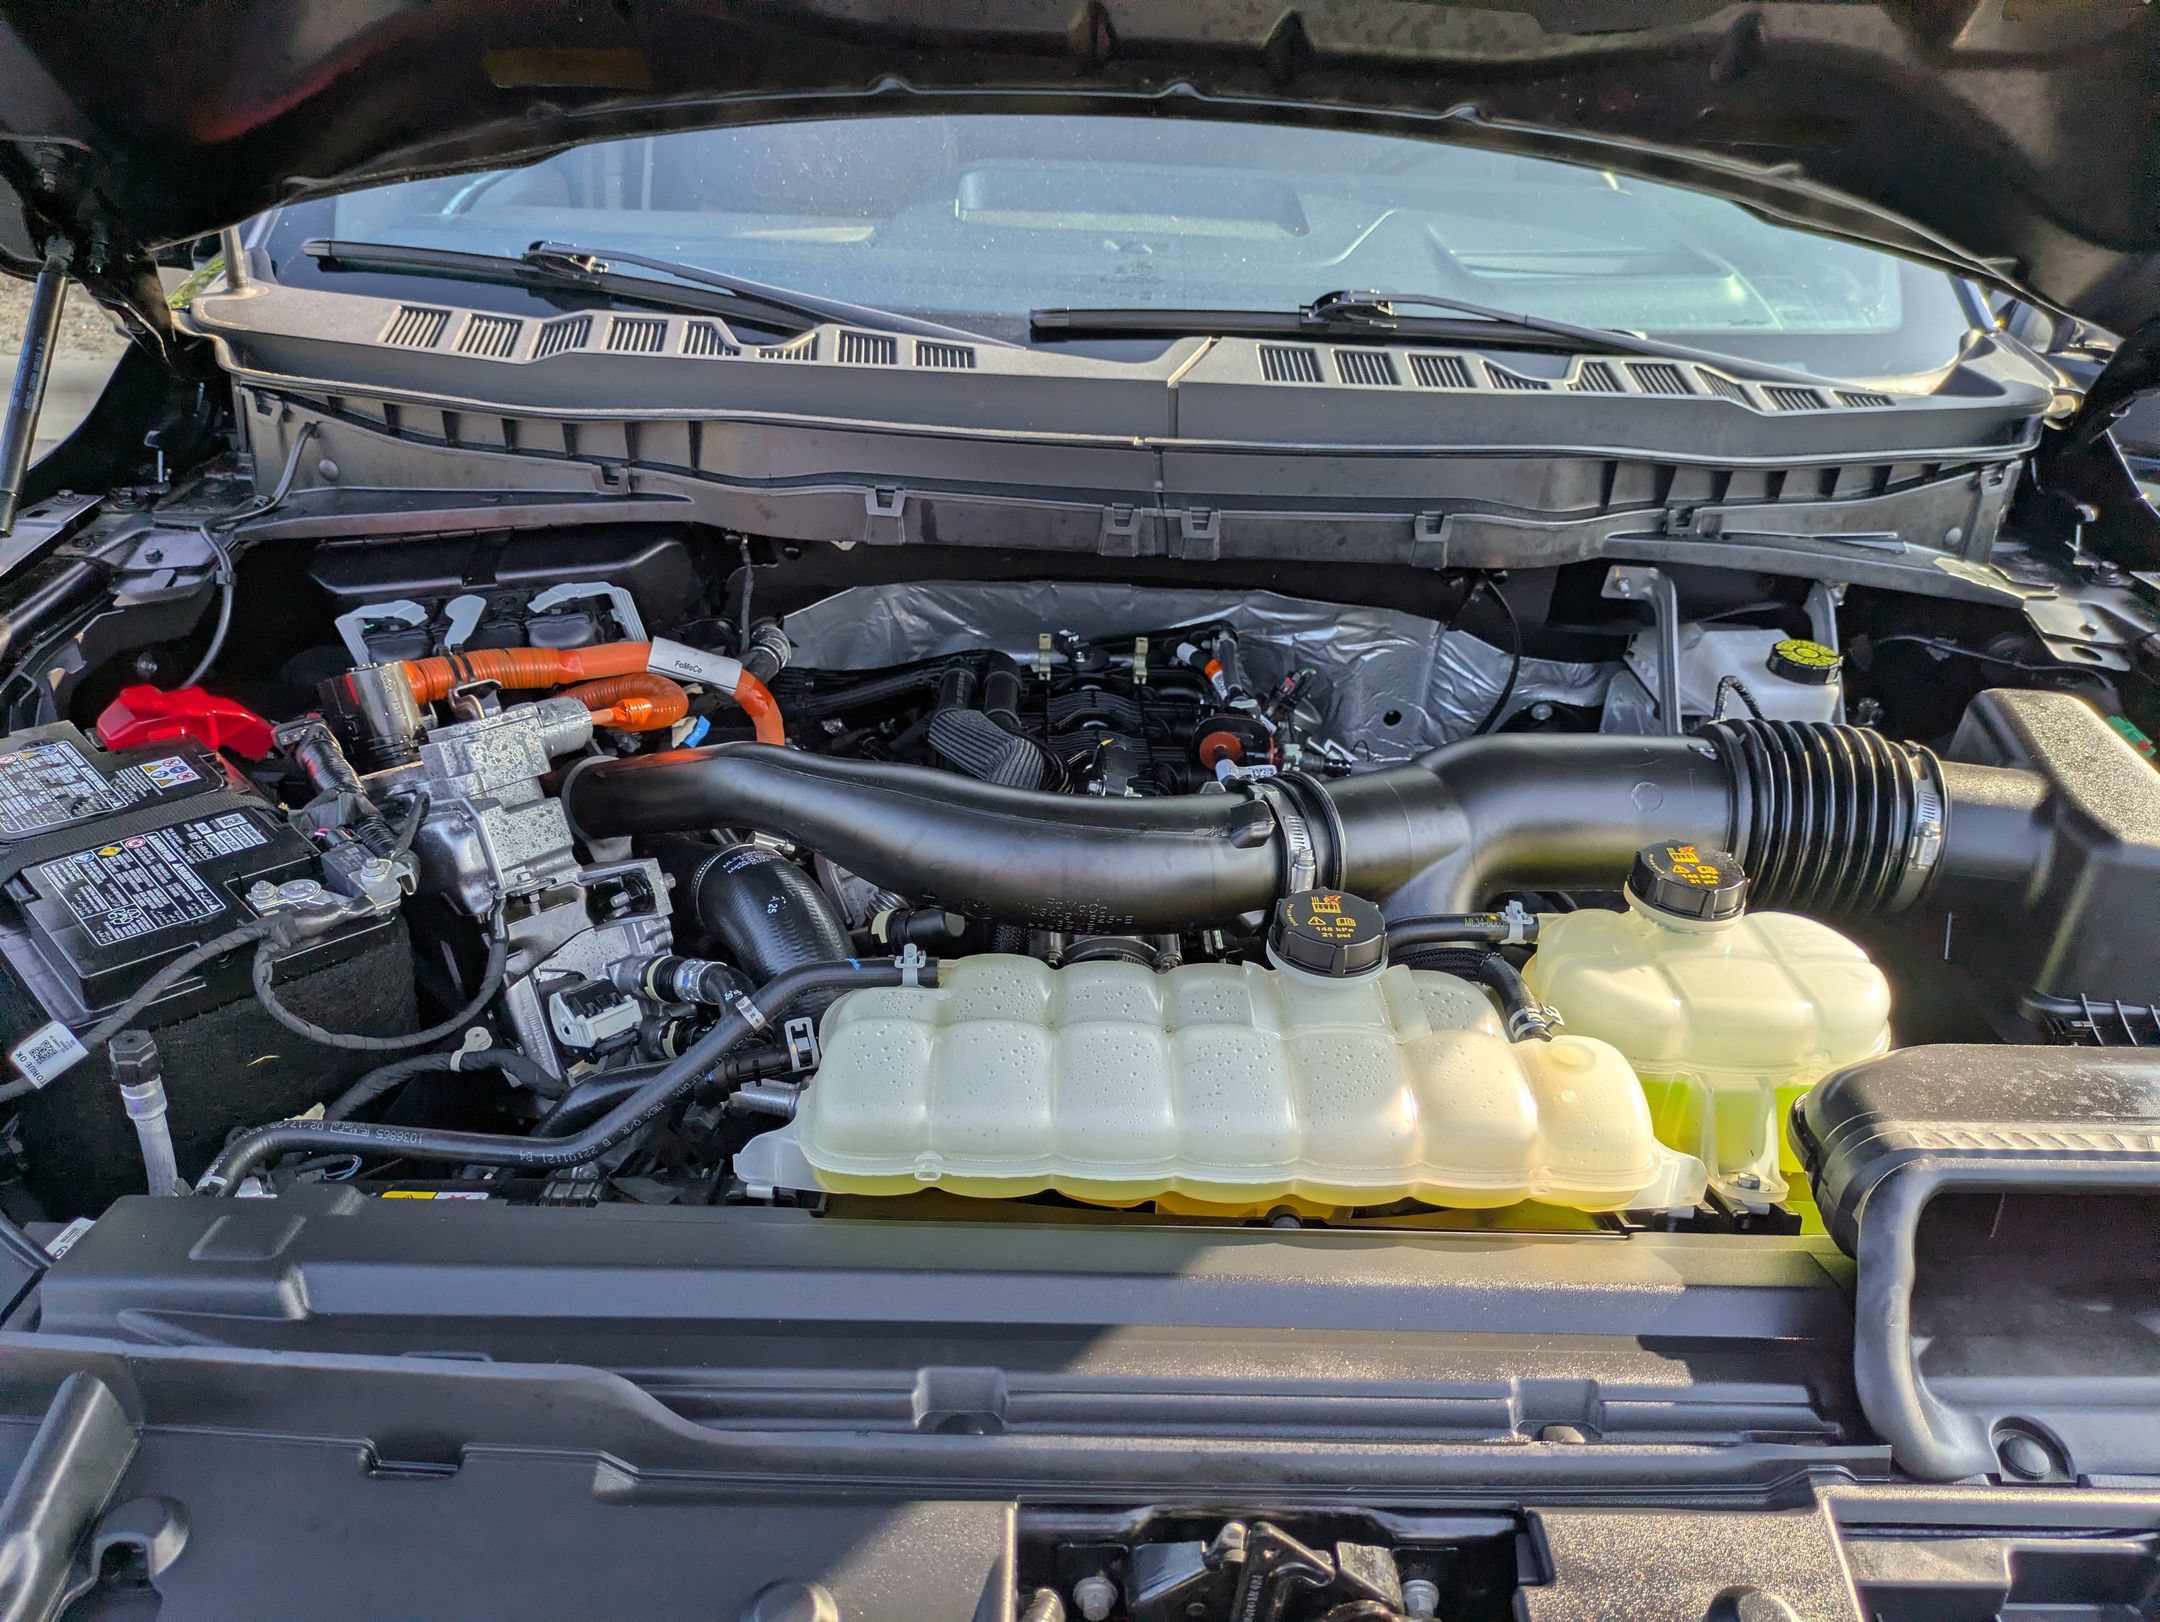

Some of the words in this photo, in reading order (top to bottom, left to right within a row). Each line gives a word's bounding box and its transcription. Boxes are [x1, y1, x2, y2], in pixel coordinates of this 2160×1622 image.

[674, 660, 703, 674] FoMoCo
[15, 1051, 28, 1062] OK
[644, 1102, 666, 1119] MEX
[375, 1128, 424, 1144] 1036865
[601, 1137, 612, 1148] B
